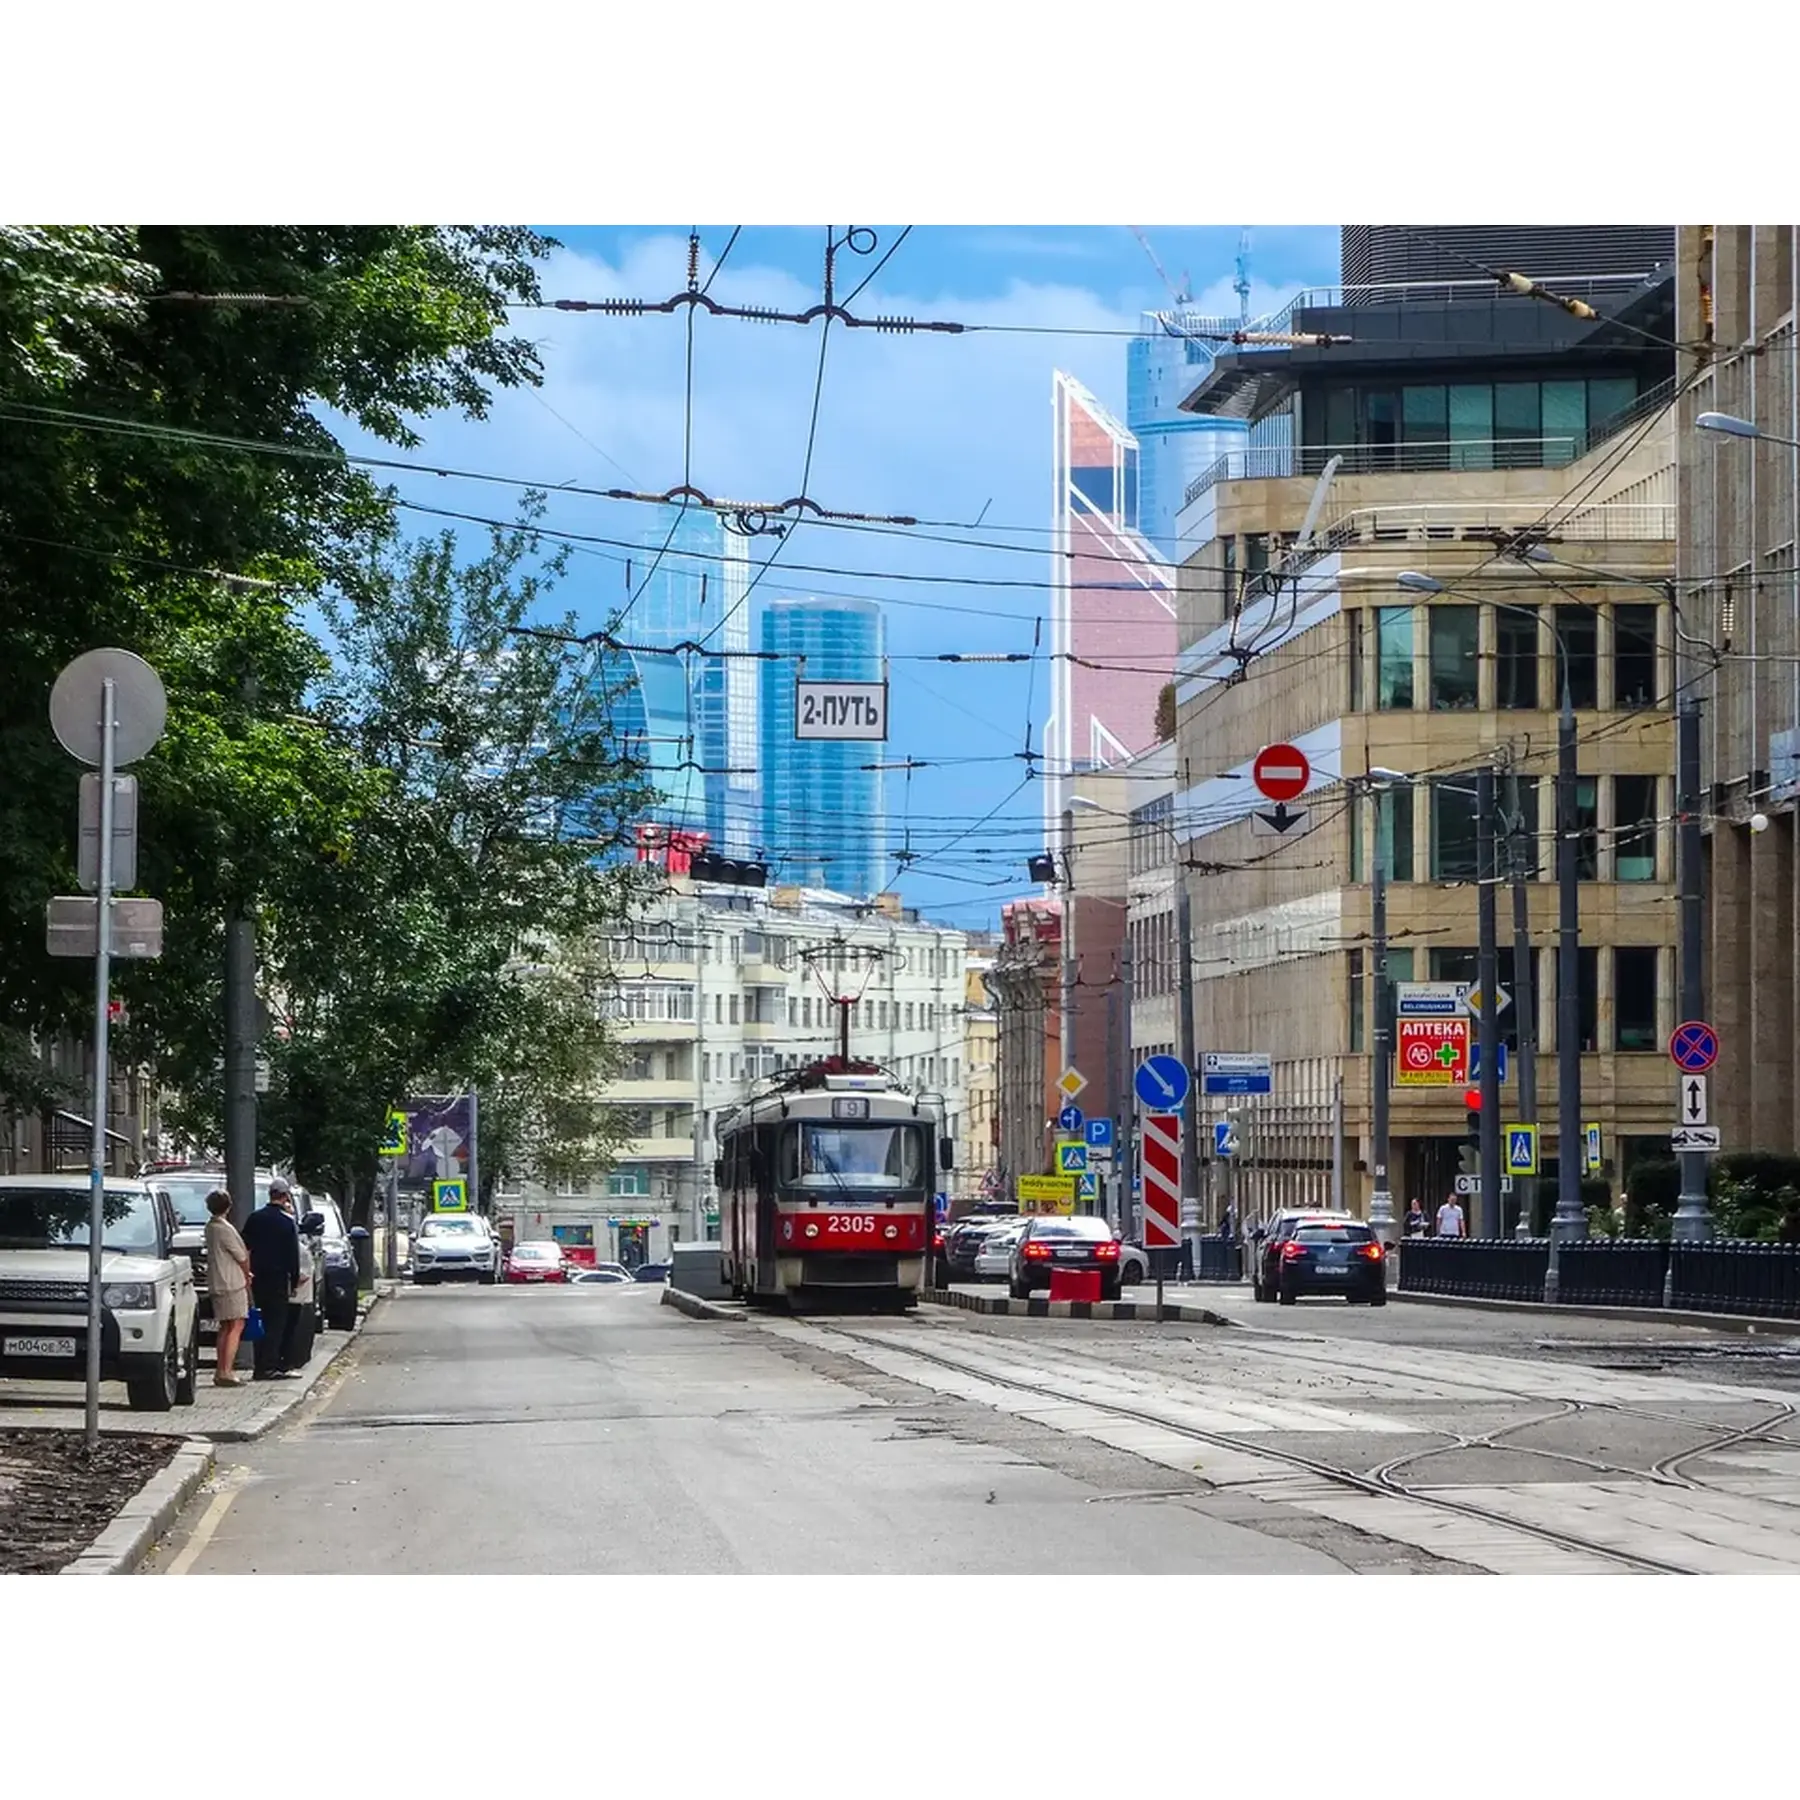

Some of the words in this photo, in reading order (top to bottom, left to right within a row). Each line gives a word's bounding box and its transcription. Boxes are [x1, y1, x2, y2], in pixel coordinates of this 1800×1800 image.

[803, 694, 878, 726] 2-ПУТЬ
[1402, 1023, 1464, 1036] АПТЕКА
[847, 1102, 857, 1116] 9
[1092, 1122, 1106, 1142] P
[1458, 1177, 1510, 1191] СТП
[828, 1215, 875, 1232] 2305
